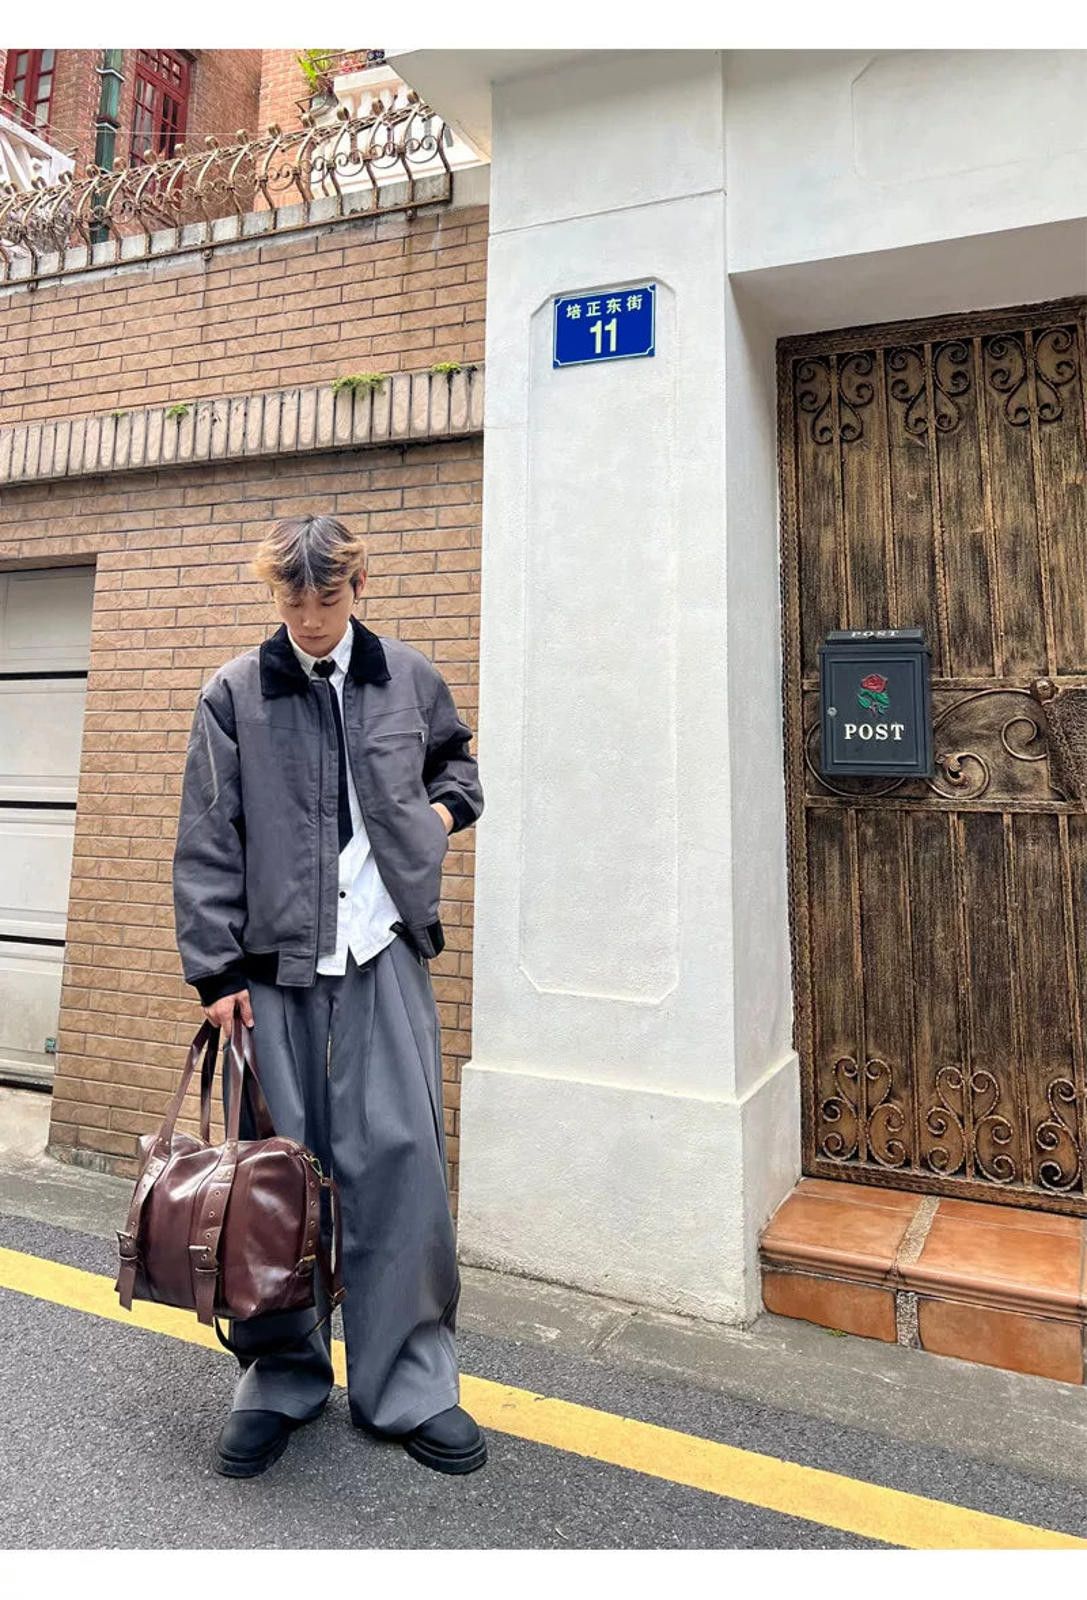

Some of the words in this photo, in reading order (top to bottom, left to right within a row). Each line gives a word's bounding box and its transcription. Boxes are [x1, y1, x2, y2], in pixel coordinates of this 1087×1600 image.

[566, 295, 643, 319] 培正东街
[590, 318, 617, 354] 11
[850, 630, 900, 638] POST
[844, 723, 905, 741] POST
